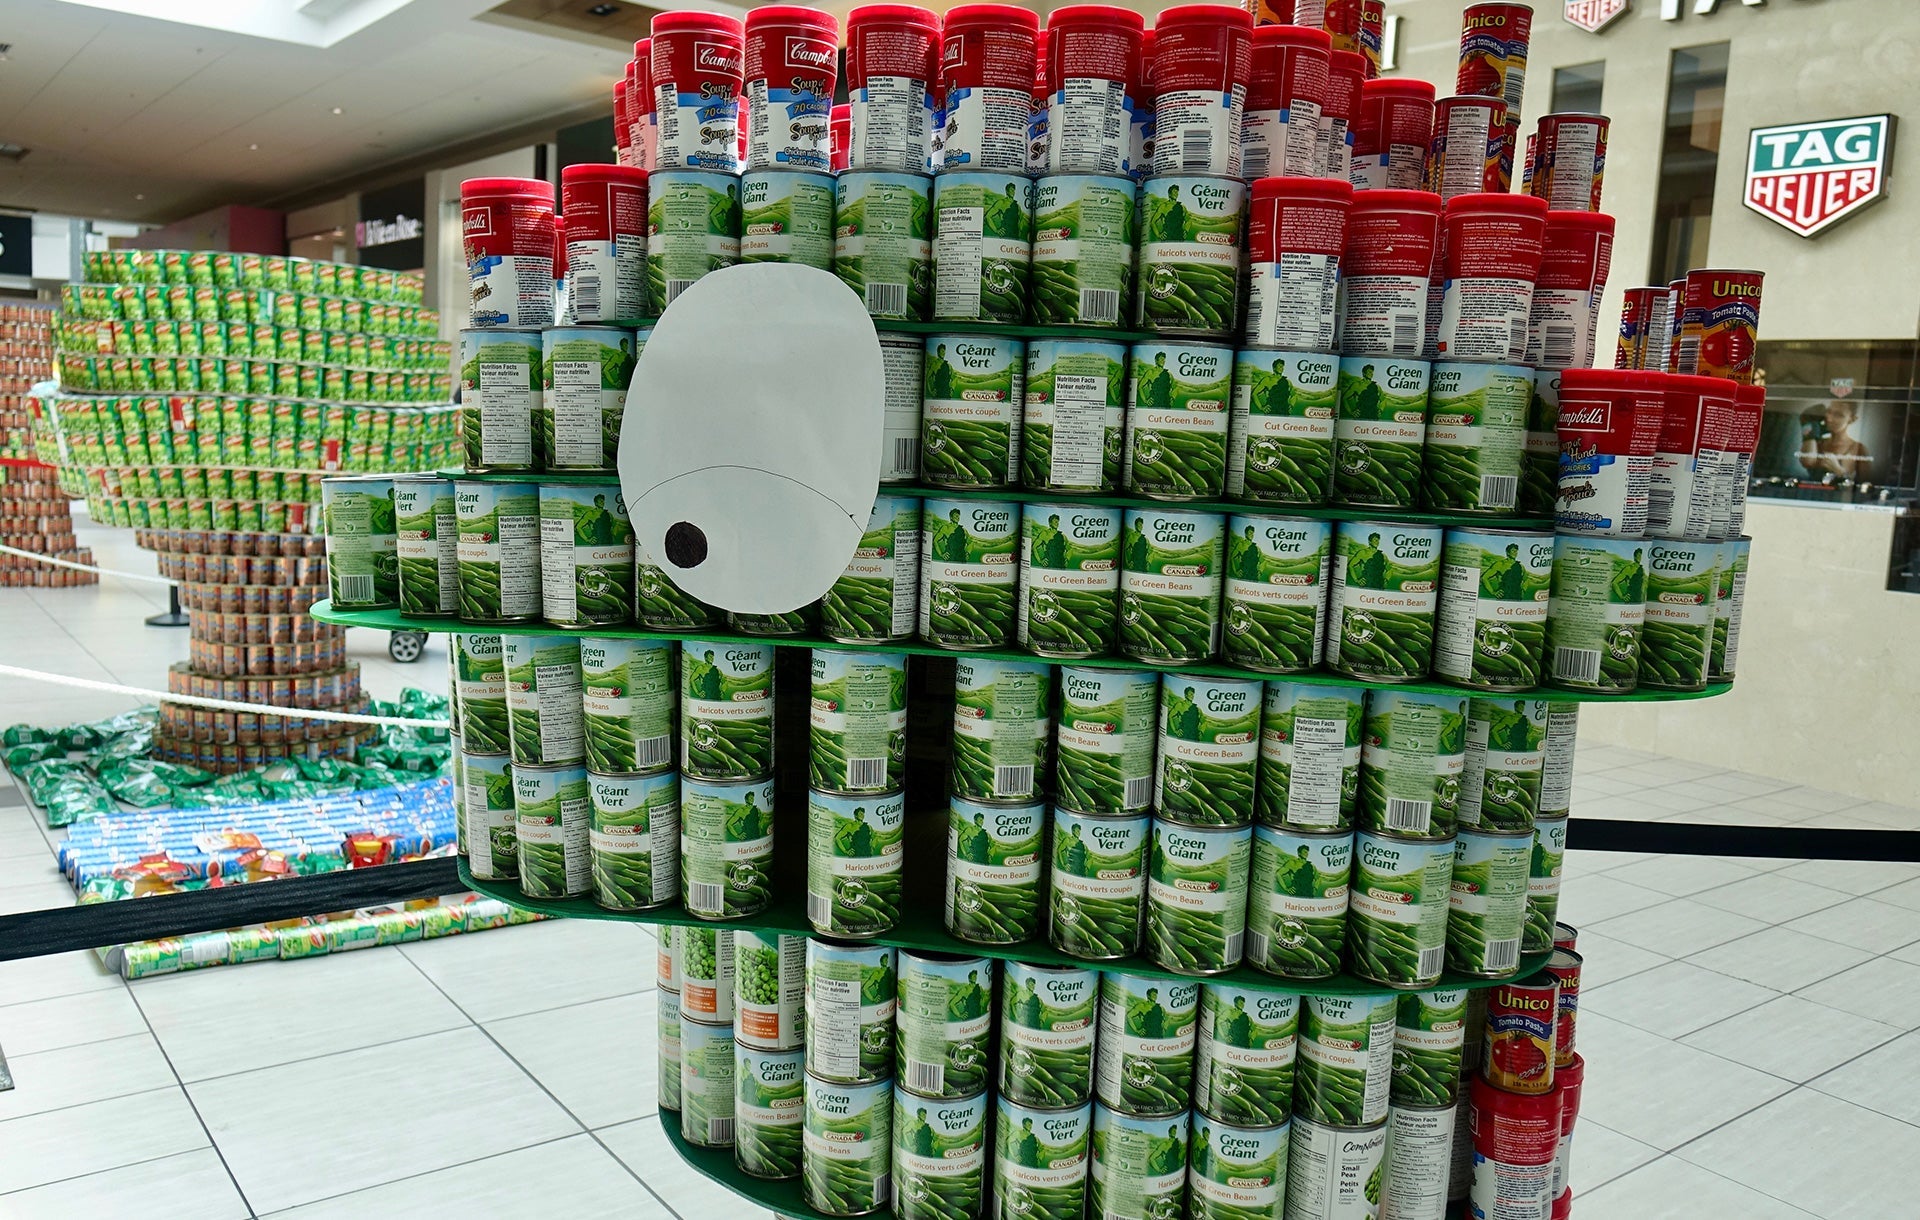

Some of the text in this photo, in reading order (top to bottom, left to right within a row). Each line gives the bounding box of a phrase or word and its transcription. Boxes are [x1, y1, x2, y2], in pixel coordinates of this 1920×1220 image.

[1477, 39, 1505, 55] tomates
[700, 82, 726, 99] Soup
[791, 77, 817, 94] Soup
[1761, 125, 1872, 168] TAG
[743, 181, 768, 191] Green
[1191, 184, 1230, 199] Géant
[1753, 171, 1873, 226] HEUER
[1037, 232, 1058, 240] CANADA
[1200, 235, 1228, 244] CANADA
[750, 241, 768, 249] Beans
[1039, 247, 1056, 255] Beans
[1157, 249, 1232, 261] Haricots verts coupés
[1713, 280, 1761, 298] Unico
[1712, 307, 1742, 319] Tomato
[956, 343, 997, 357] Géant
[1178, 352, 1218, 366] Green
[1179, 365, 1216, 378] Giant
[1297, 359, 1332, 373] Green
[1387, 365, 1422, 379] Green
[1057, 376, 1079, 384] Nutrition
[1298, 372, 1330, 385] Giant
[1388, 377, 1421, 390] Giant
[930, 405, 1000, 417] Haricots verts coupés
[1148, 415, 1214, 426] Cut Green Beans
[1435, 431, 1456, 439] Beans
[459, 503, 474, 513] Vert
[972, 509, 1009, 522] Green
[1071, 515, 1109, 527] Green
[974, 521, 1008, 533] Giant
[1153, 518, 1195, 532] Green
[1073, 527, 1108, 538] Giant
[1154, 531, 1194, 544] Giant
[1272, 539, 1301, 552] Vert
[1392, 534, 1432, 547] Green
[466, 550, 487, 558] coupés
[1394, 546, 1430, 559] Giant
[858, 564, 882, 573] coupés
[1652, 558, 1693, 572] Giant
[1043, 575, 1107, 585] Cut Green Beans
[1359, 595, 1427, 607] Cut Green Beans
[1663, 596, 1695, 604] CANADA
[725, 650, 762, 661] Géant
[1067, 675, 1101, 690] Green
[1206, 688, 1247, 701] Green
[698, 706, 724, 715] Haricots
[745, 705, 766, 714] coupés
[1208, 700, 1245, 712] Giant
[1296, 718, 1319, 726] Nutrition
[1177, 745, 1243, 758] Cut Green Beans
[596, 784, 629, 796] Géant
[995, 815, 1032, 825] Green
[997, 825, 1030, 837] Giant
[1168, 833, 1206, 849] Green
[1363, 841, 1400, 860] Green
[1007, 858, 1032, 866] CANADA
[1062, 878, 1133, 894] Haricots verts coupés
[1371, 893, 1399, 903] CANADA
[1285, 902, 1333, 912] Haricots verts
[1047, 980, 1084, 992] Géant
[1256, 997, 1292, 1009] Green
[1433, 993, 1457, 1004] Vert
[1499, 990, 1549, 1010] Unico
[1258, 1007, 1290, 1020] Giant
[960, 1025, 982, 1035] Haricots
[1056, 1023, 1082, 1031] CANADA
[1499, 1018, 1544, 1034] Tomato Paste
[1140, 1043, 1179, 1052] Cut Green
[760, 1061, 796, 1072] Green
[762, 1072, 796, 1081] Giant
[816, 1100, 849, 1114] Giant
[753, 1112, 799, 1120] Green Beans
[937, 1108, 974, 1120] Géant
[1396, 1113, 1421, 1122] Nutrition
[1396, 1120, 1414, 1128] Valeur
[1050, 1129, 1074, 1141] Vert
[1221, 1144, 1257, 1159] Giant
[1231, 1179, 1261, 1188] CANADA
